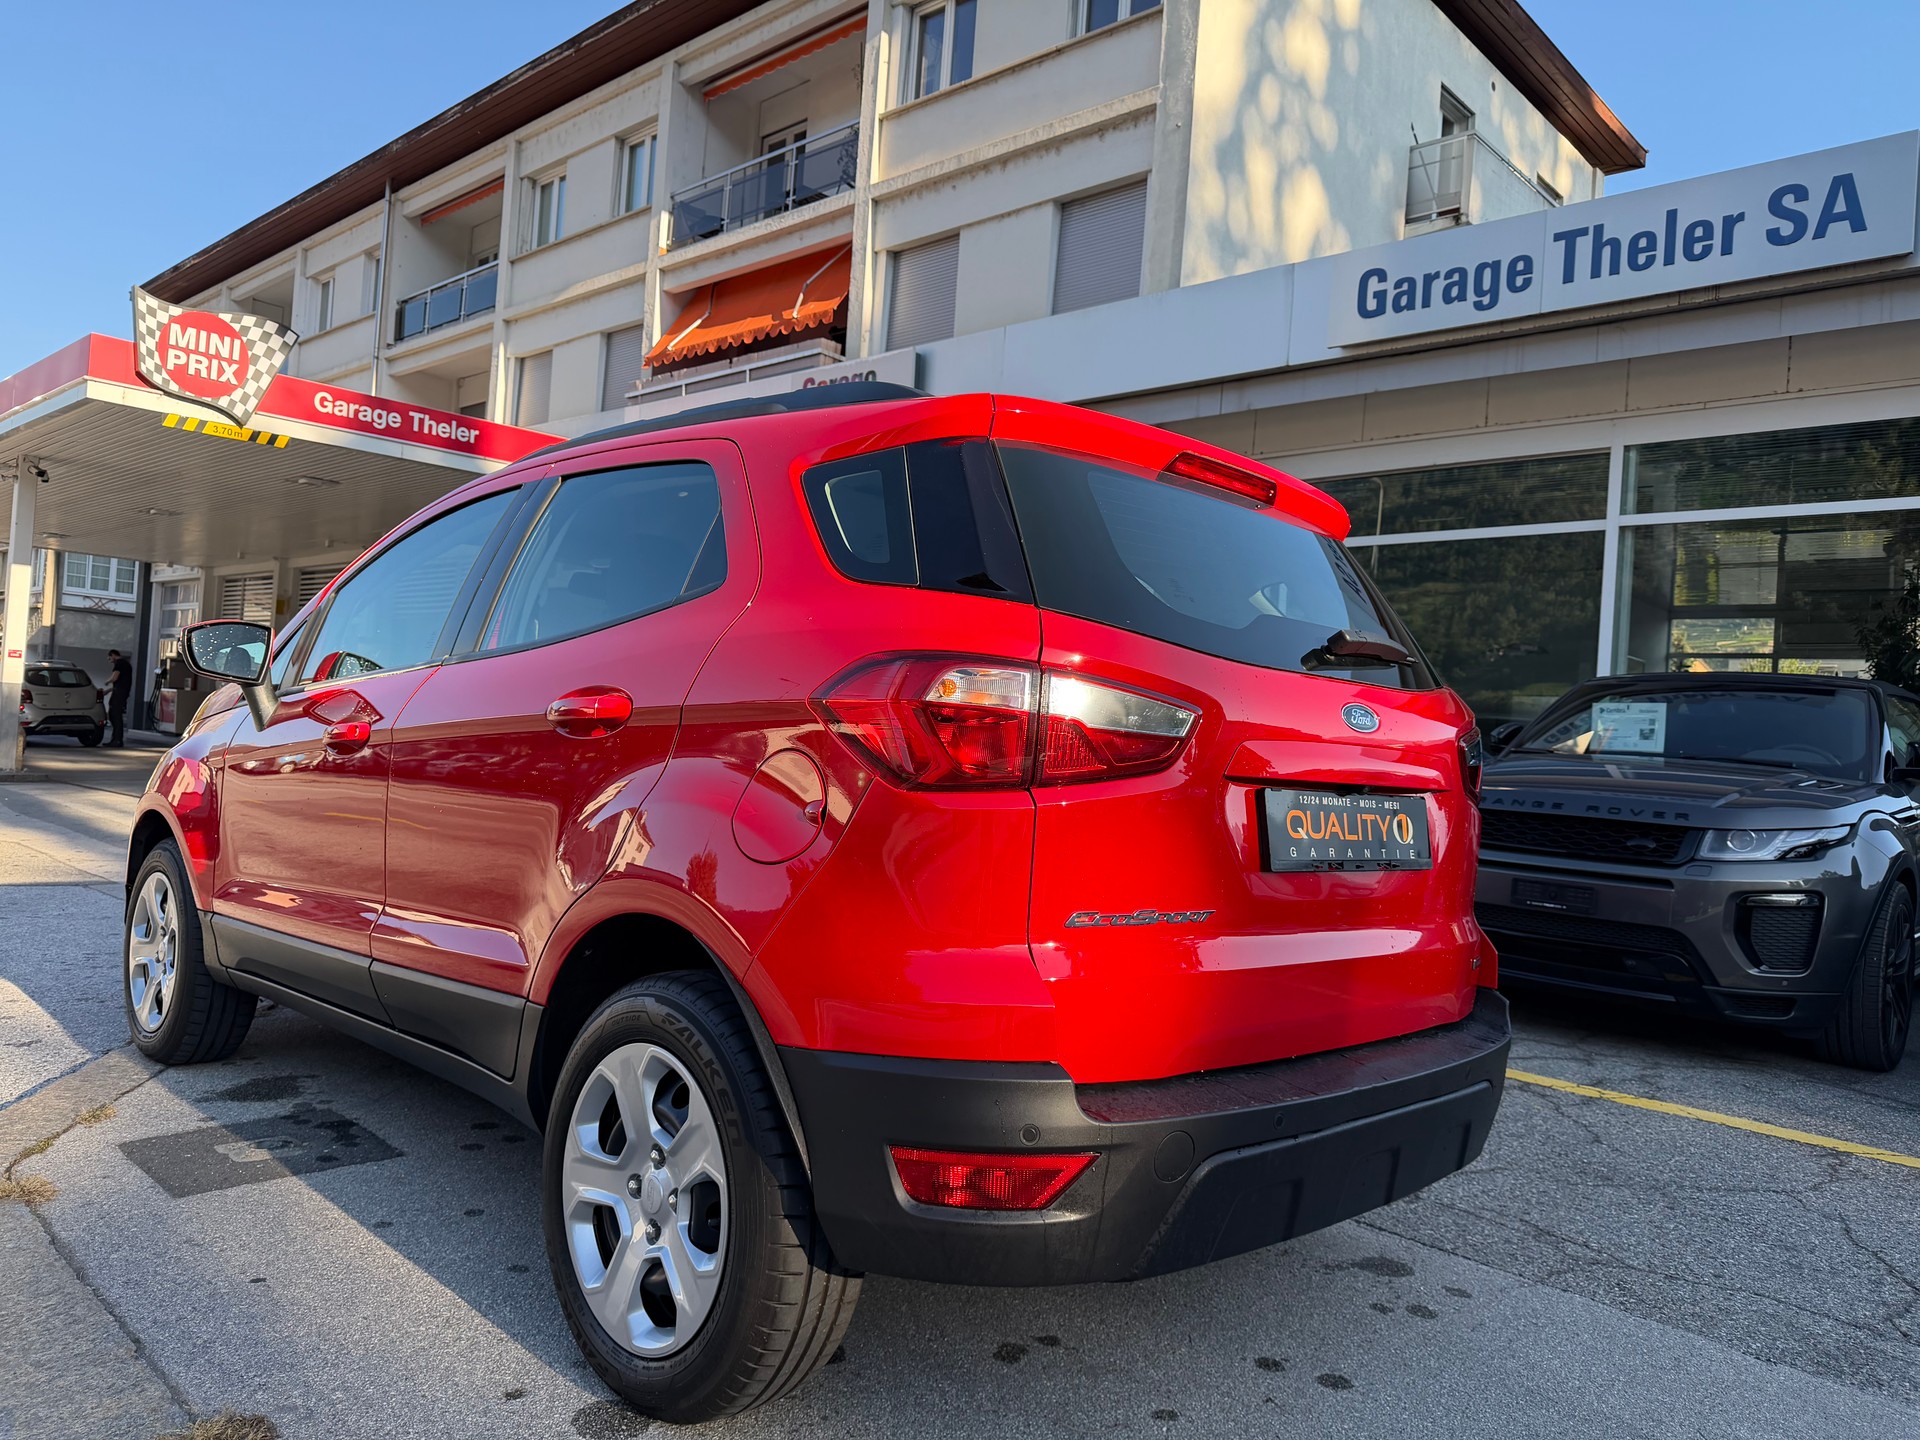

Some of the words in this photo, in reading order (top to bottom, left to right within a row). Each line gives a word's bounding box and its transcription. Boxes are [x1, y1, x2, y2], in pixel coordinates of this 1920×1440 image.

[1356, 253, 1534, 320] Garage
[1553, 208, 1746, 285] Theler
[1765, 172, 1868, 247] SA
[168, 322, 242, 362] MINI
[166, 349, 240, 386] PRIX
[313, 391, 402, 430] Garage
[409, 411, 480, 445] Theler
[1350, 708, 1372, 726] Ford
[1299, 795, 1320, 804] 12/24
[1322, 796, 1351, 806] MONATE
[1359, 799, 1376, 808] MOIS
[1384, 801, 1400, 810] MESI
[1585, 804, 1690, 821] ROVER
[1286, 809, 1390, 842] QUALITY
[1289, 846, 1416, 859] GARANTIE
